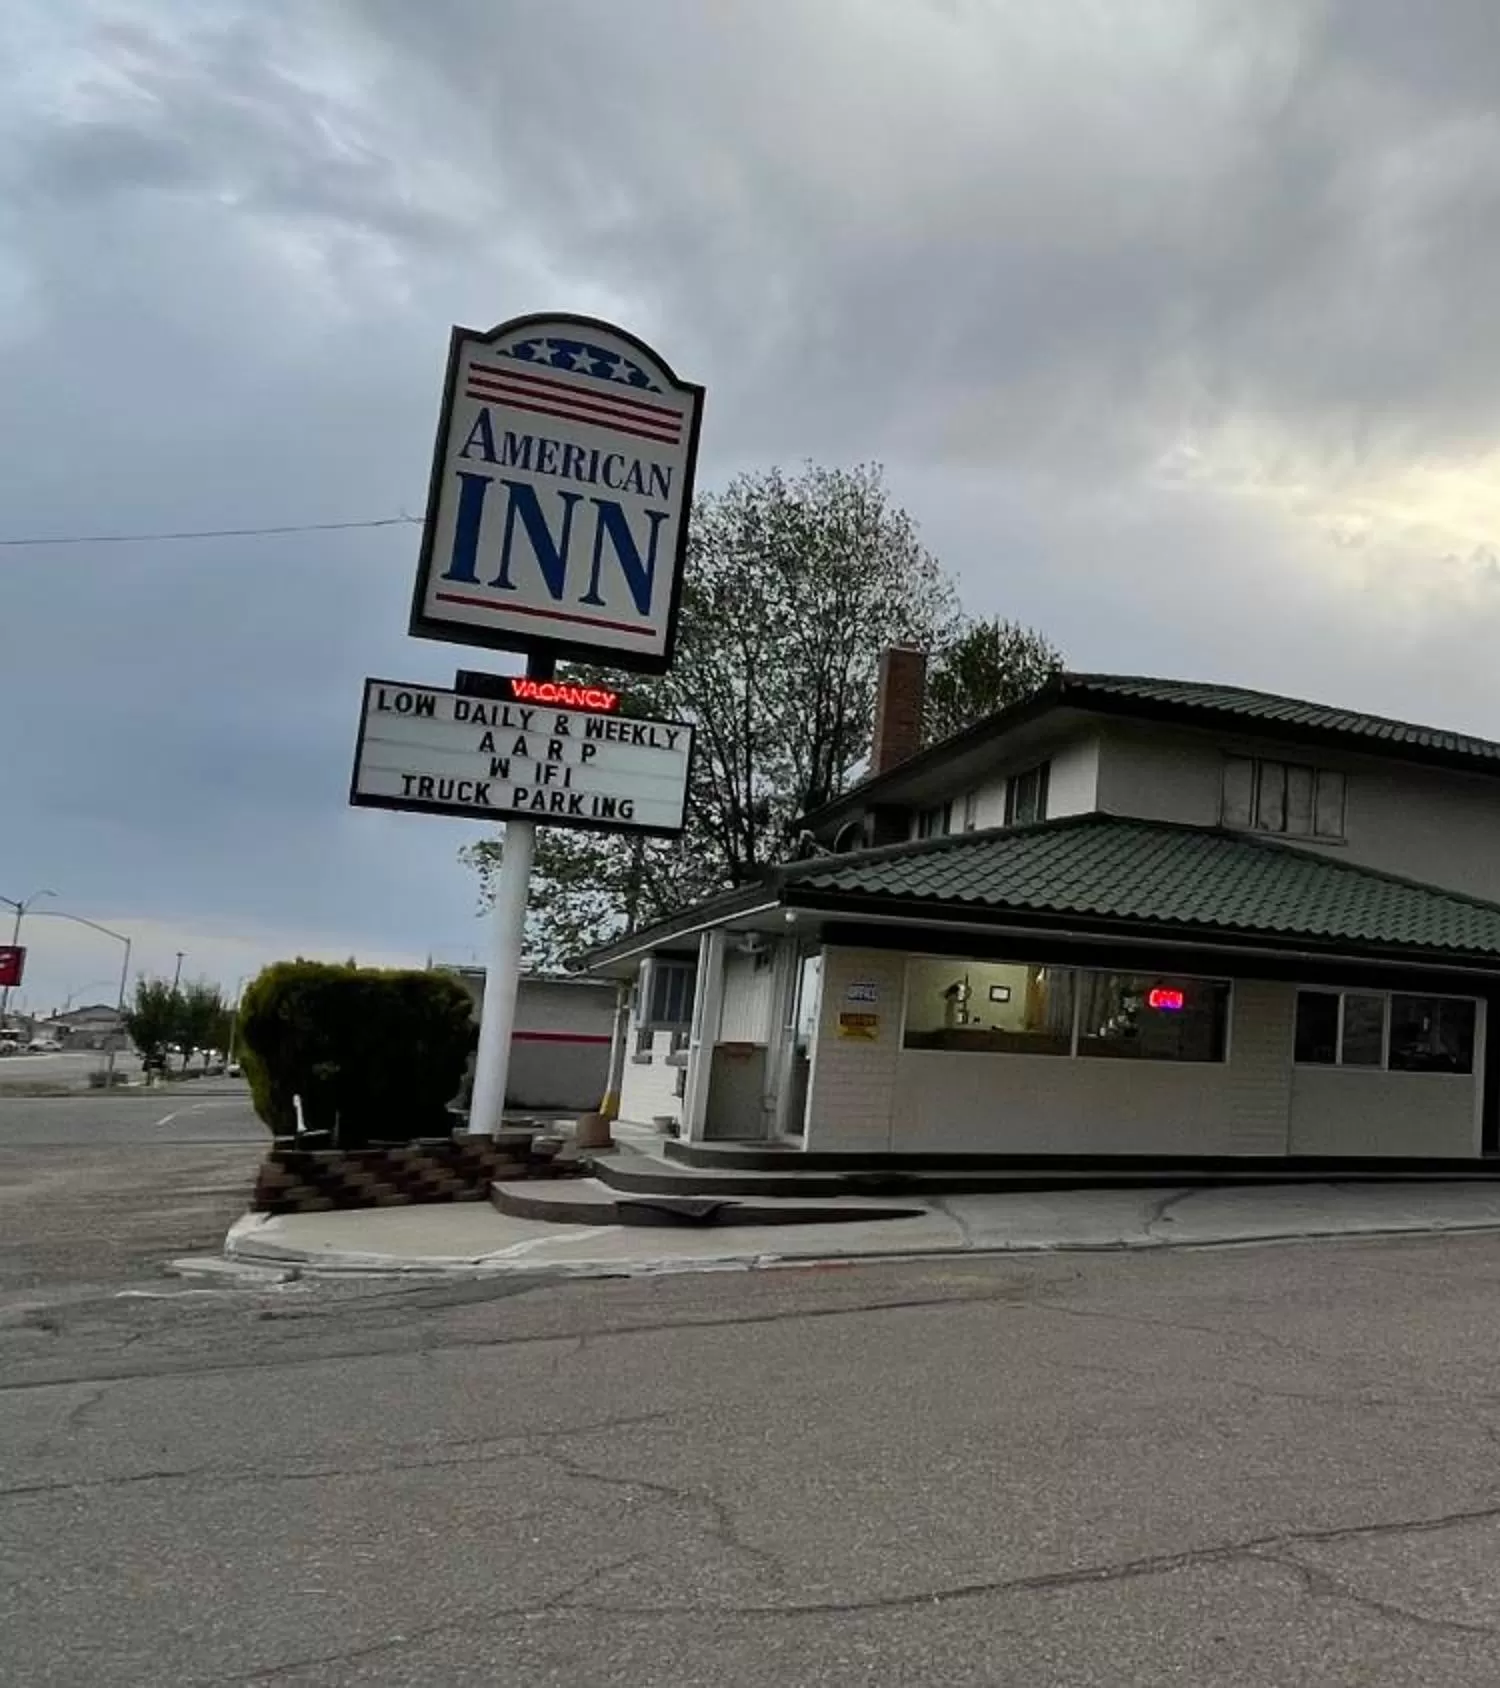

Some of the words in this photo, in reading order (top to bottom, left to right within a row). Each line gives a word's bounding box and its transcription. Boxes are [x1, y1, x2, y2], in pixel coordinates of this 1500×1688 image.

[458, 407, 673, 500] AMERICAN
[440, 471, 670, 617] INN
[377, 688, 437, 717] LOW
[454, 700, 535, 730] DAILY
[585, 717, 679, 750] WEEKLY
[511, 679, 617, 708] VACANCY
[401, 774, 491, 805] TRUCK
[512, 787, 635, 819] PARKING
